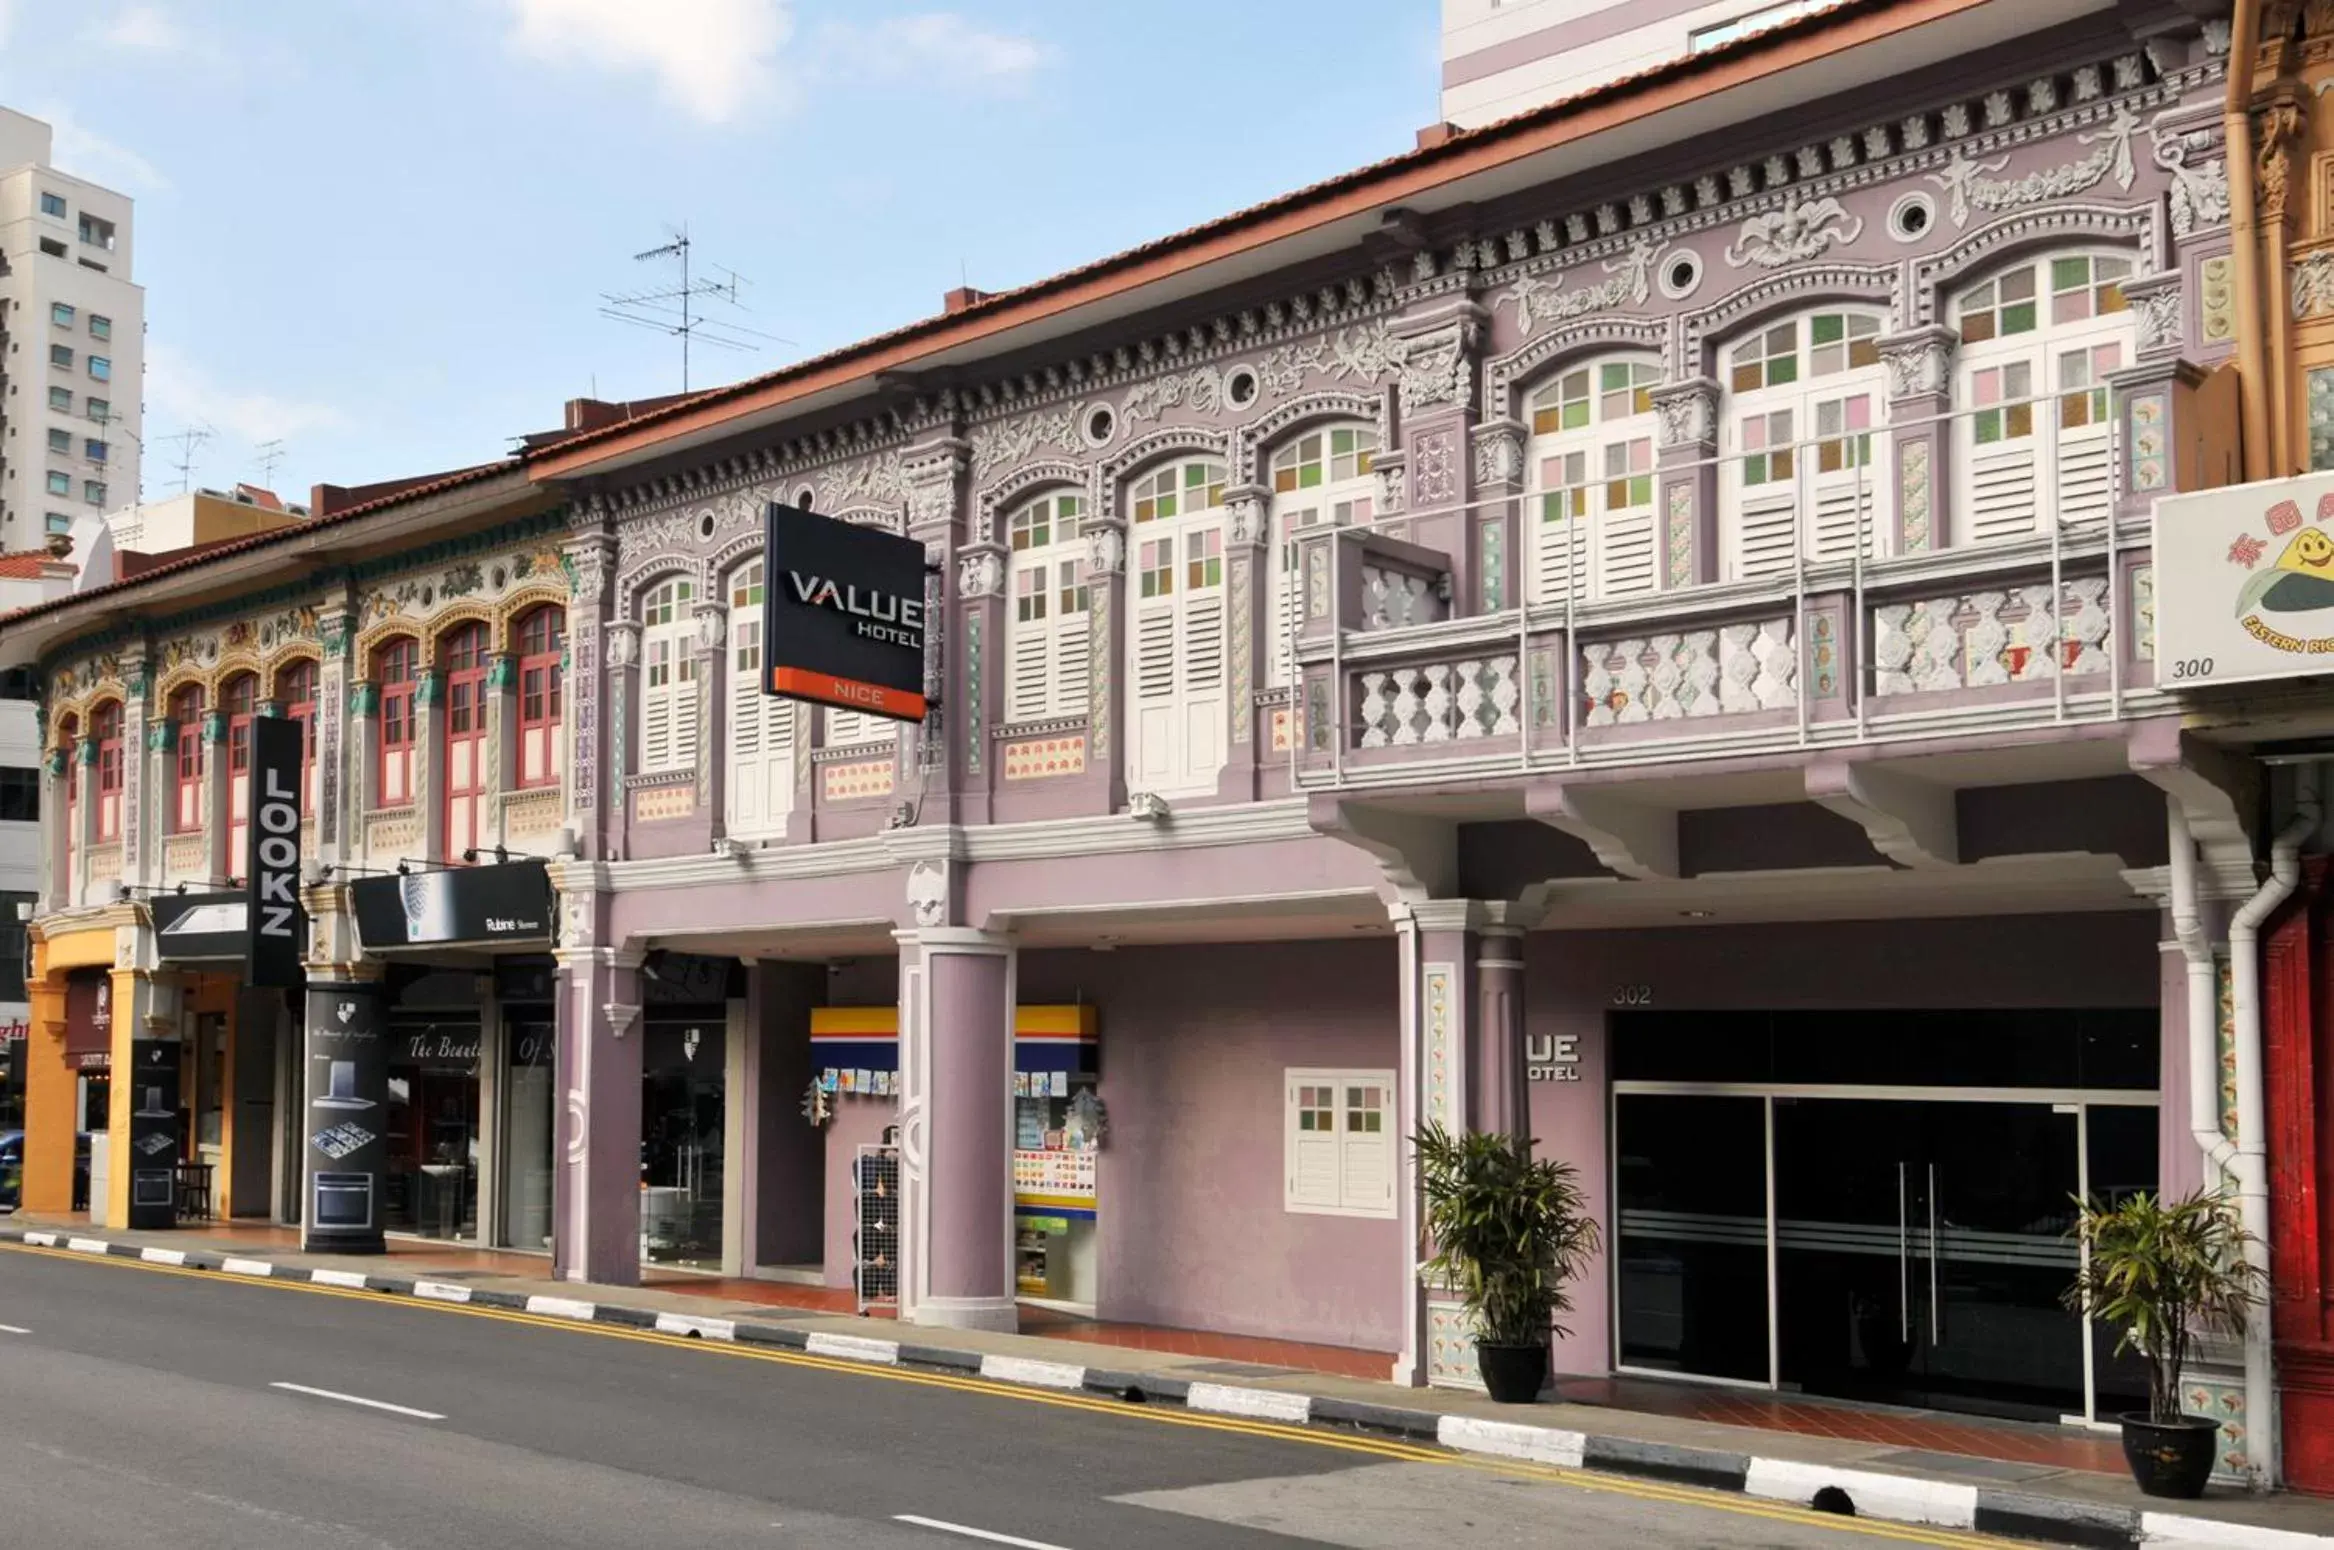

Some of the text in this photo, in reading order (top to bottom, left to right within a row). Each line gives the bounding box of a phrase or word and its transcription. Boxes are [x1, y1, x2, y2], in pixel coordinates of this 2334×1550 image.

[790, 570, 923, 628] VALUE
[857, 621, 921, 648] HOTEL
[2241, 614, 2334, 654] EASTERN RIC
[2172, 657, 2214, 679] 300
[834, 679, 884, 706] NICE
[259, 768, 298, 937] LOOKZ
[1613, 985, 1653, 1005] 302
[409, 1035, 433, 1058] The
[438, 1036, 482, 1070] Beaut
[1526, 1034, 1579, 1062] UE
[1528, 1066, 1579, 1081] OTEL
